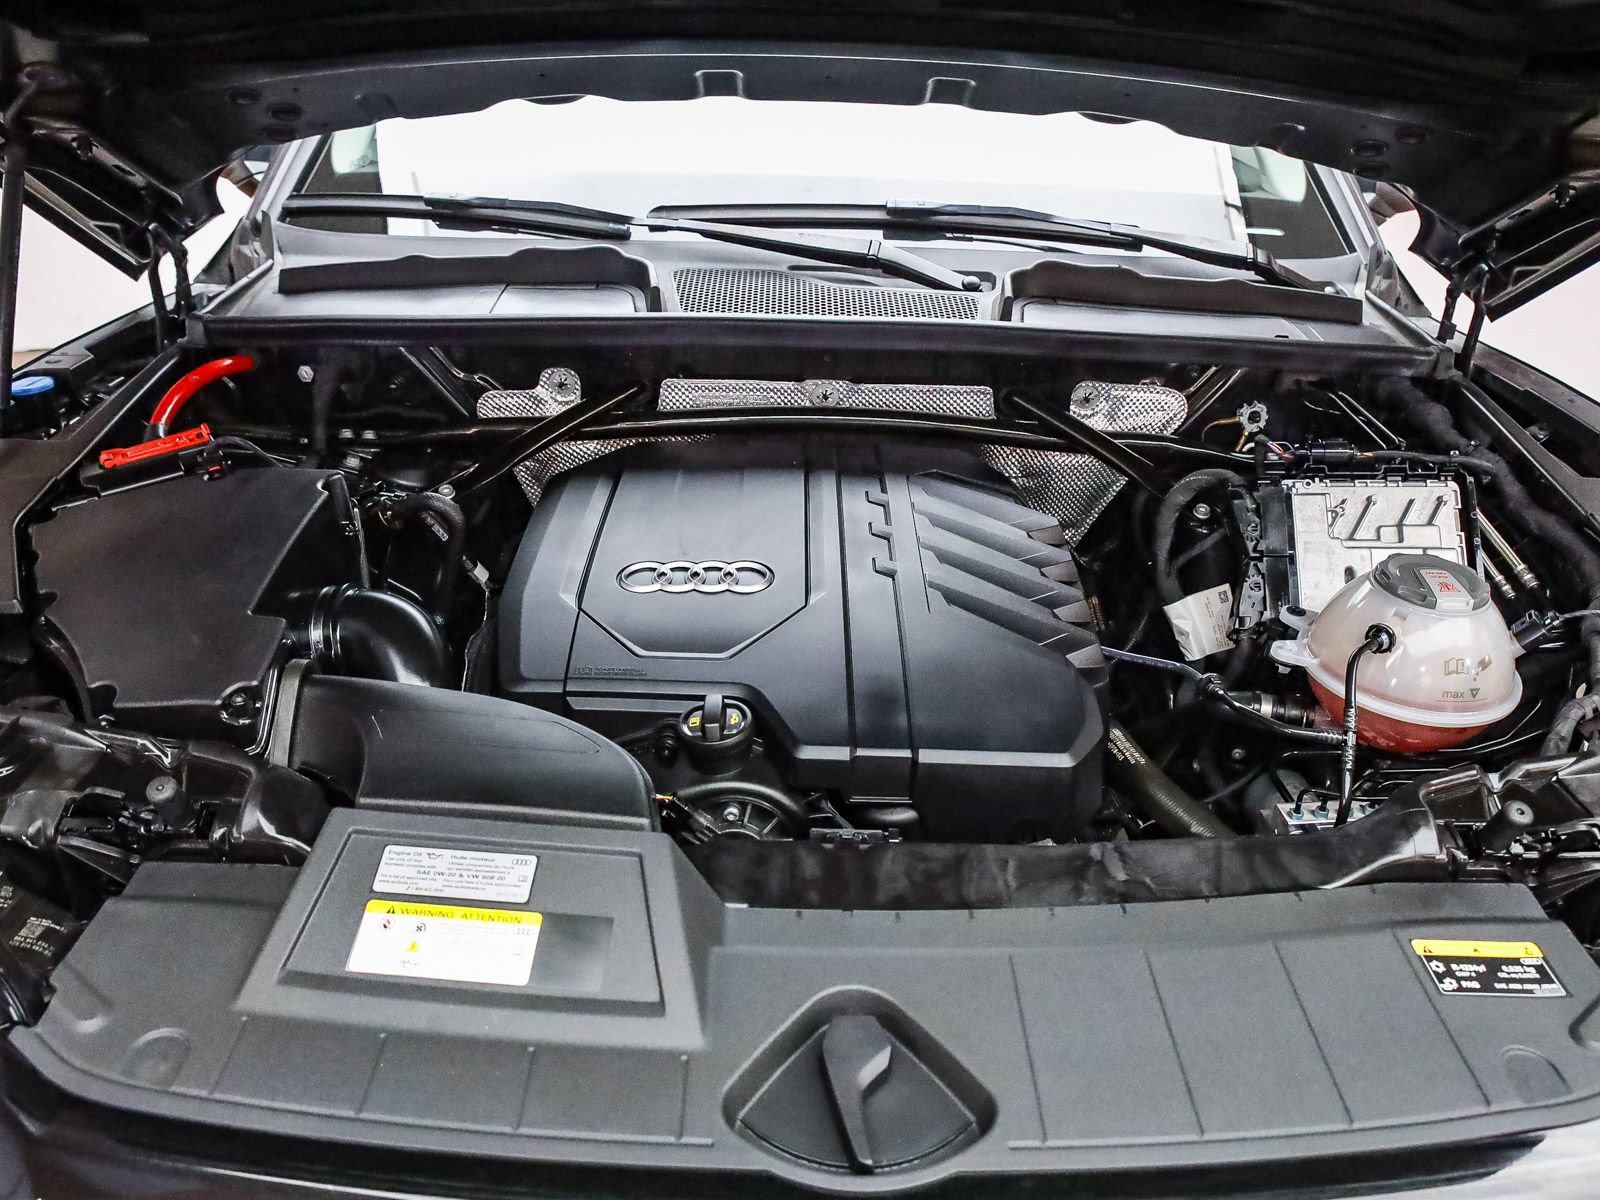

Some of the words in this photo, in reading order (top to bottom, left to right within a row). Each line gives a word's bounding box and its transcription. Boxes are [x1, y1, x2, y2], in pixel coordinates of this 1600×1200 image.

[1442, 690, 1465, 699] max
[400, 907, 454, 919] WARNING
[460, 911, 523, 924] ATTENTION
